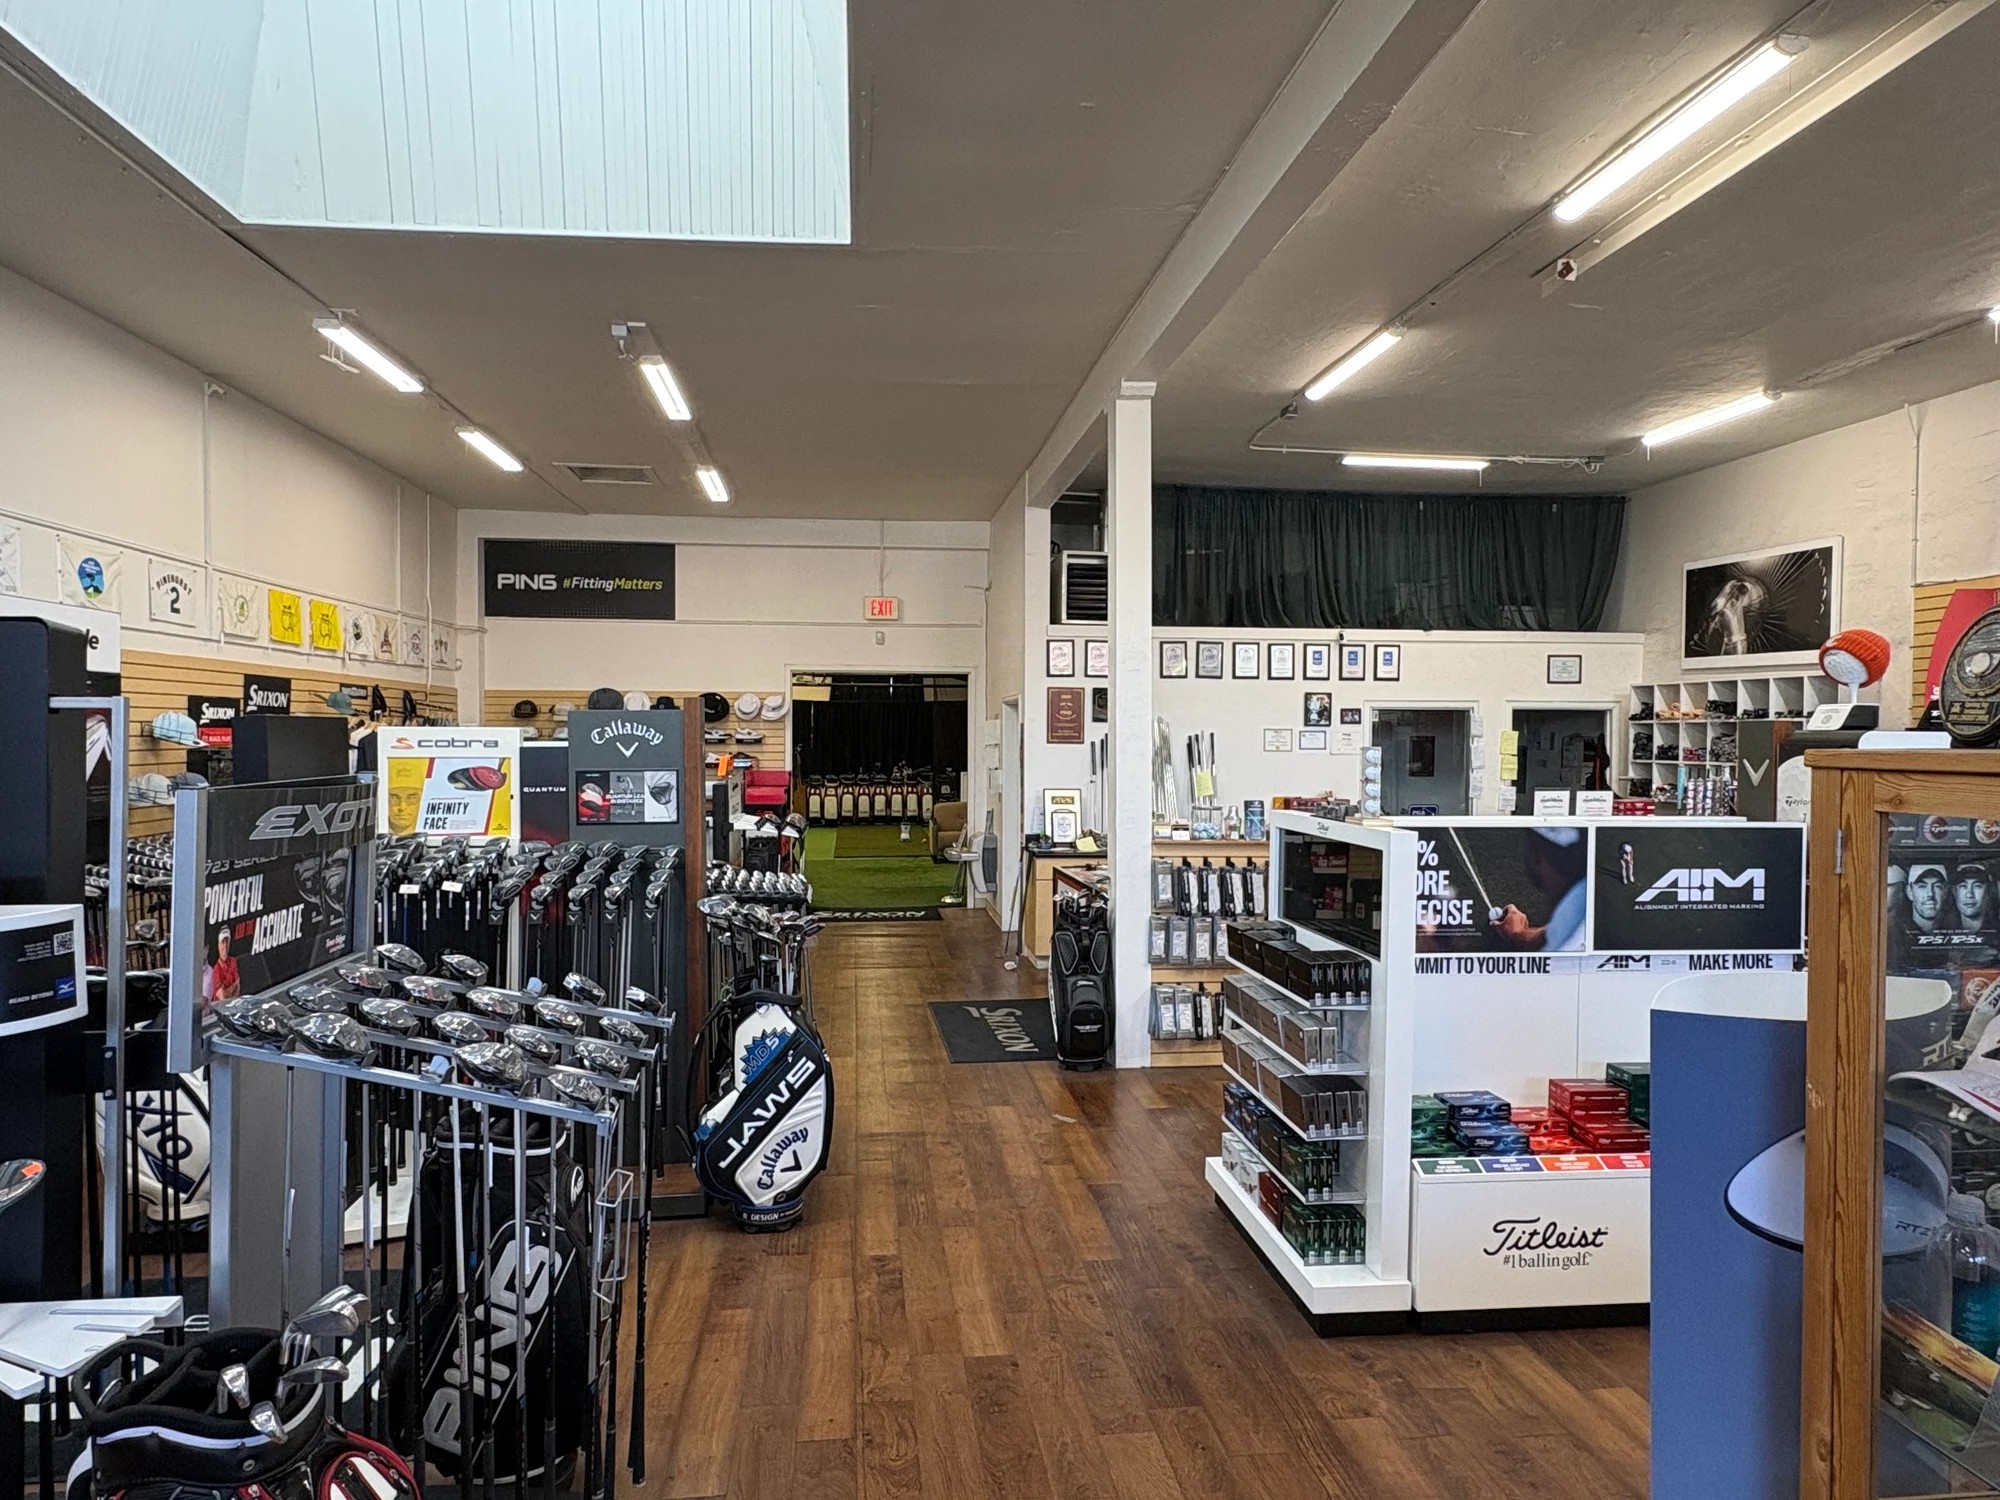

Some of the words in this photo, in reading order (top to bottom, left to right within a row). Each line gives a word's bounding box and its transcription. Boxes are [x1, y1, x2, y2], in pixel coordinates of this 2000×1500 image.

[155, 573, 193, 595] PINEHURST
[496, 573, 557, 591] PING
[562, 576, 663, 592] #FittingMatters
[169, 586, 181, 615] 2
[870, 599, 893, 617] EXIT
[248, 684, 289, 708] SRIXON
[201, 703, 236, 720] SRIXON
[417, 736, 499, 748] cobra
[590, 718, 664, 747] Callaway
[425, 802, 470, 815] INFINITY
[423, 817, 447, 830] FACE
[1634, 868, 1765, 902] AIM
[204, 874, 264, 925] POWERFUL
[251, 903, 305, 955] ACCURATE
[1456, 956, 1474, 974] TO
[1477, 956, 1517, 974] YOUR
[1519, 956, 1551, 974] LINE
[1596, 954, 1651, 969] AIM
[1689, 954, 1730, 971] MAKE
[1733, 953, 1773, 970] MORE
[980, 1007, 1040, 1053] SRIXON
[746, 1036, 780, 1076] MD5
[718, 1056, 816, 1169] JAWS
[757, 1126, 810, 1190] Callaway
[750, 1213, 779, 1221] DESIGN
[1483, 1216, 1608, 1256] Titleist
[422, 1239, 563, 1457] PING
